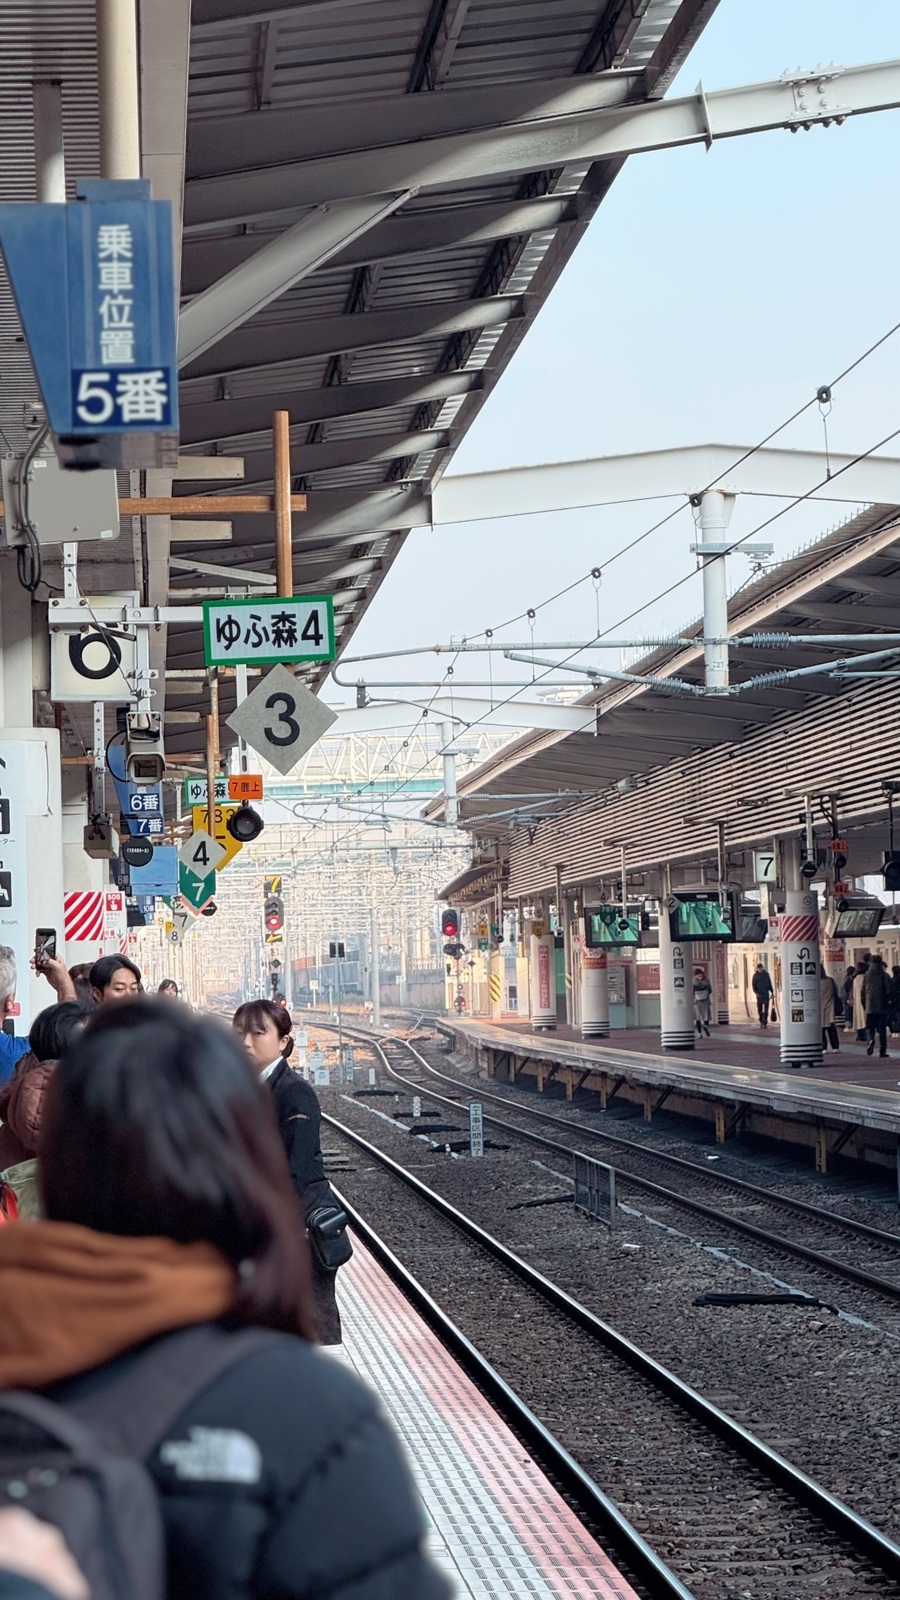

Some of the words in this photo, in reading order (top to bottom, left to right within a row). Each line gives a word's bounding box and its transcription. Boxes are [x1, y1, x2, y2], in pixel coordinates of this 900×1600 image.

[97, 224, 136, 365] 乗車位置
[75, 370, 168, 424] 5番
[215, 608, 324, 650] ゆふ森4
[263, 692, 301, 747] 3
[130, 794, 159, 811] 6番
[137, 818, 163, 833] 7番
[192, 840, 210, 866] 4
[759, 857, 775, 877] 7
[191, 882, 206, 902] 7
[667, 896, 675, 908] 2
[171, 930, 179, 942] 8
